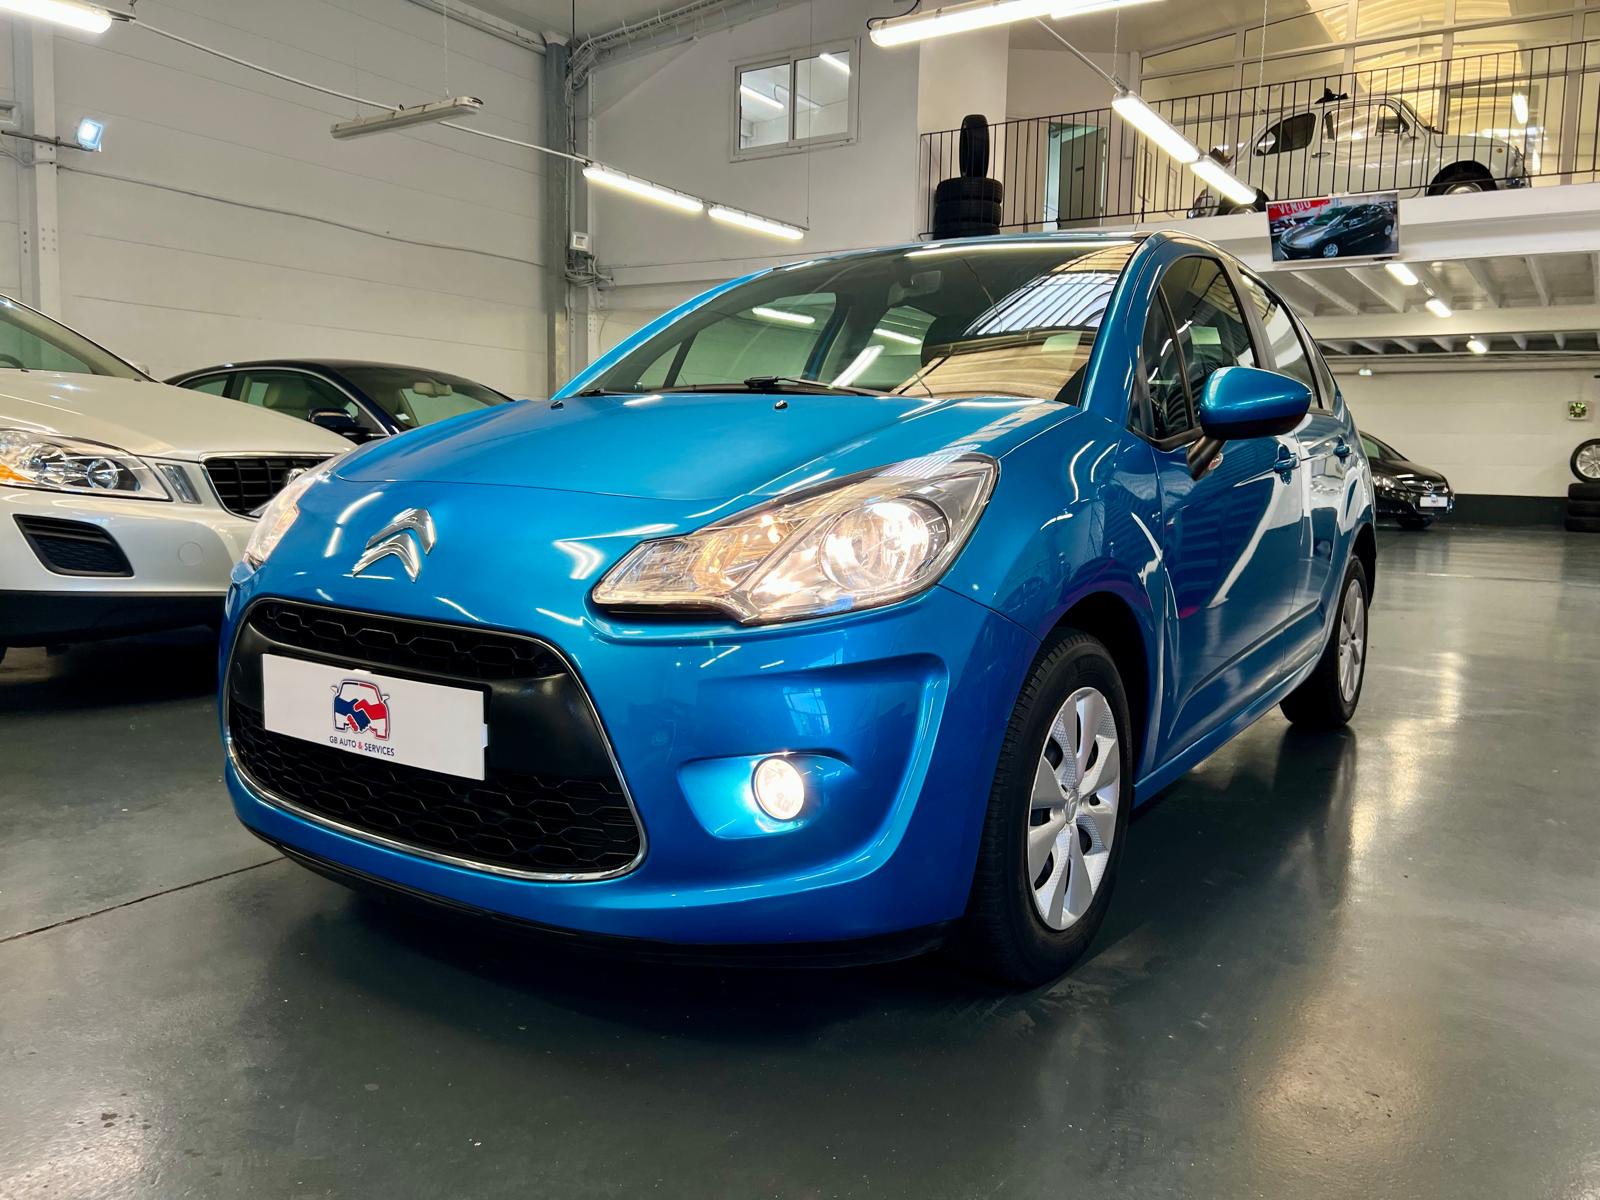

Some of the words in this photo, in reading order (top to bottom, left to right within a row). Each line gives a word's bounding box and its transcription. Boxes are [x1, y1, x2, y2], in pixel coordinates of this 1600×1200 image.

[329, 735, 338, 744] GB
[339, 738, 357, 748] AUTO
[357, 741, 364, 750] &
[364, 742, 395, 757] SERVICES
